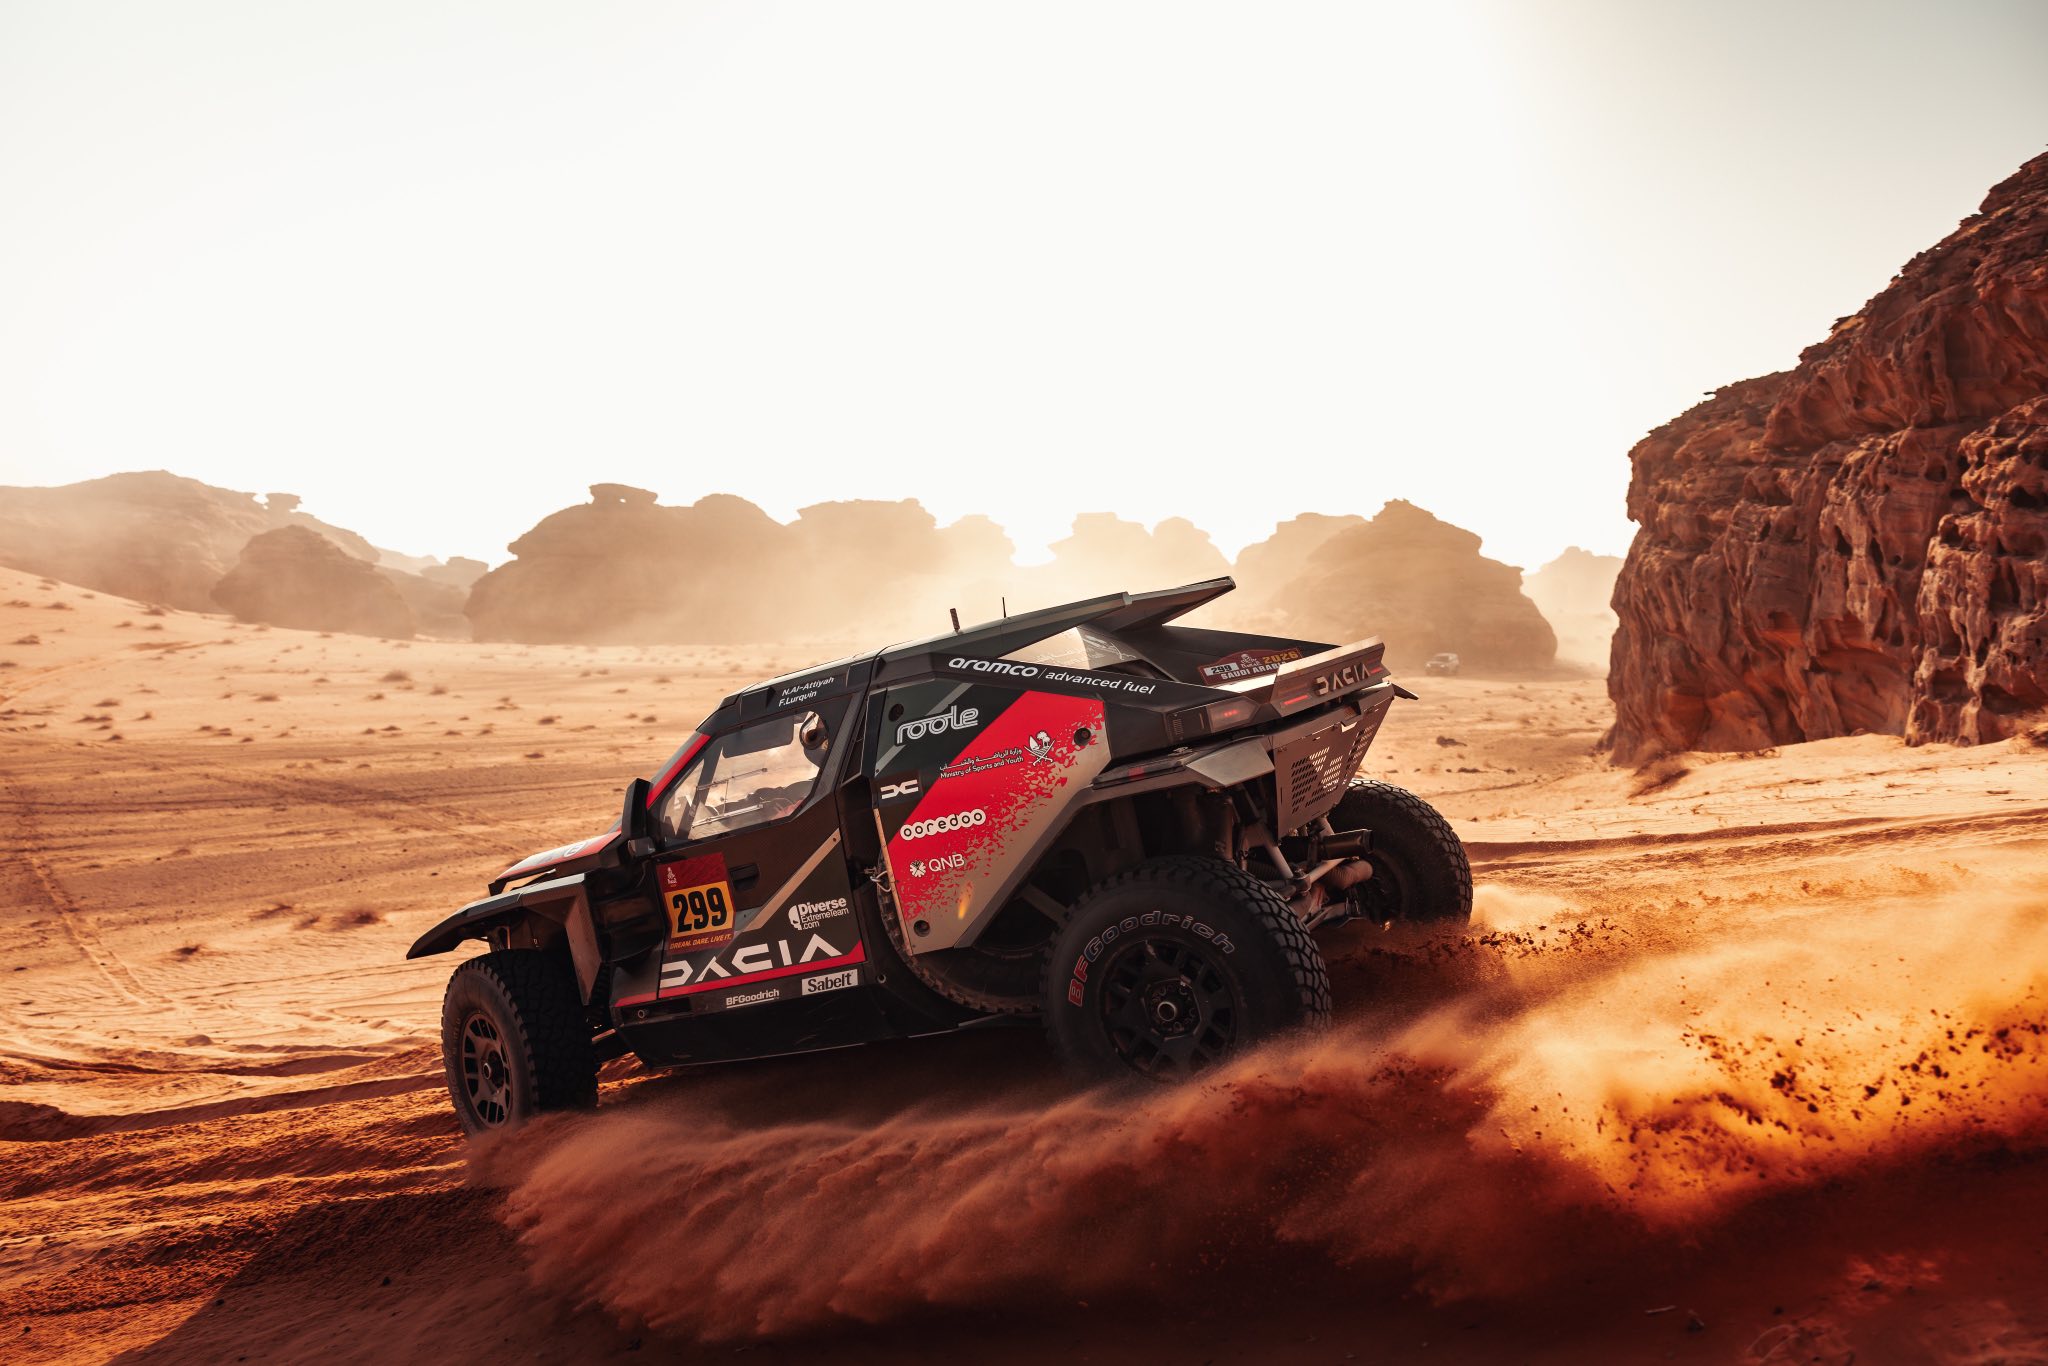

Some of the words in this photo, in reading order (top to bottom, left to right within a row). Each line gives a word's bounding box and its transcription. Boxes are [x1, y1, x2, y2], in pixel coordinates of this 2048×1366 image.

[948, 657, 1039, 677] aramco
[1263, 651, 1298, 664] 2026
[1211, 665, 1232, 673] 299
[1221, 668, 1251, 680] SAUDI
[1252, 661, 1286, 674] ARABI
[1045, 671, 1121, 689] advanced
[1123, 681, 1156, 695] fuel
[1316, 664, 1371, 695] DACIA
[778, 691, 817, 707] F.Lurquin
[897, 705, 979, 744] roole
[940, 770, 965, 779] Ministry
[972, 763, 993, 773] Sports
[993, 760, 1005, 768] and
[1006, 756, 1024, 765] Youth
[902, 811, 984, 838] ooredoo
[928, 854, 965, 873] QNB
[672, 887, 728, 933] 299
[798, 898, 847, 916] Diverse
[800, 907, 850, 924] ExtremeTeam
[802, 920, 820, 930] .com
[669, 940, 691, 950] DREAM.
[692, 937, 709, 946] DARE.
[710, 934, 724, 943] LIVE
[659, 933, 842, 988] DACIA
[1068, 911, 1235, 1008] BFGoodrich
[807, 972, 852, 992] Sabelt
[726, 988, 780, 1006] BFGoodrich
